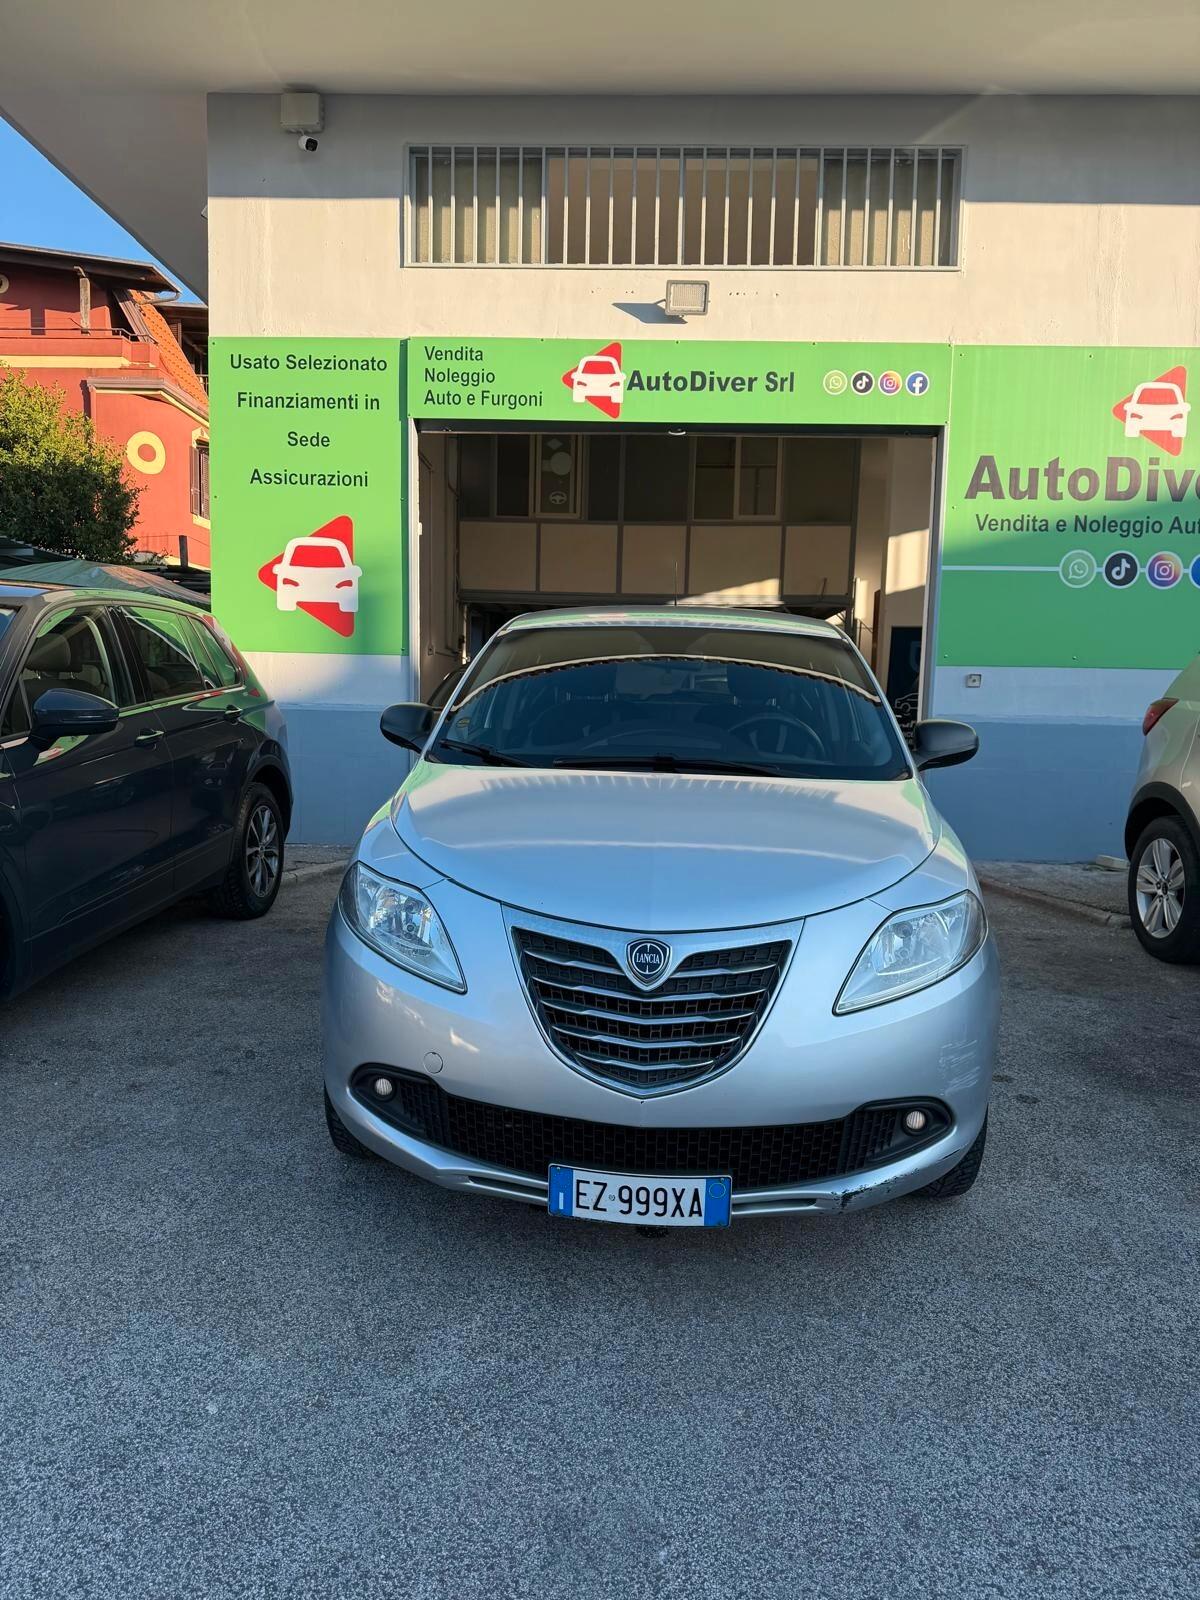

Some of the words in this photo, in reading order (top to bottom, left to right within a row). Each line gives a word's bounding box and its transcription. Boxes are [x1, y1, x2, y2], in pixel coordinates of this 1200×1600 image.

[424, 346, 484, 361] Vendita
[230, 354, 280, 370] Usato
[286, 355, 388, 371] Selezionato
[424, 368, 496, 385] Noleggio
[627, 370, 758, 392] AutoDiver
[765, 372, 795, 393] Srl
[237, 392, 359, 410] Finanziamenti
[364, 394, 380, 410] in
[424, 390, 462, 406] Auto
[466, 393, 476, 406] e
[481, 390, 543, 408] Furgoni
[287, 431, 330, 448] Sede
[250, 469, 369, 487] Assicurazioni
[975, 514, 1049, 533] Vendita
[1055, 519, 1067, 533] e
[1074, 515, 1163, 538] Noleggio
[636, 952, 660, 964] LANCIA
